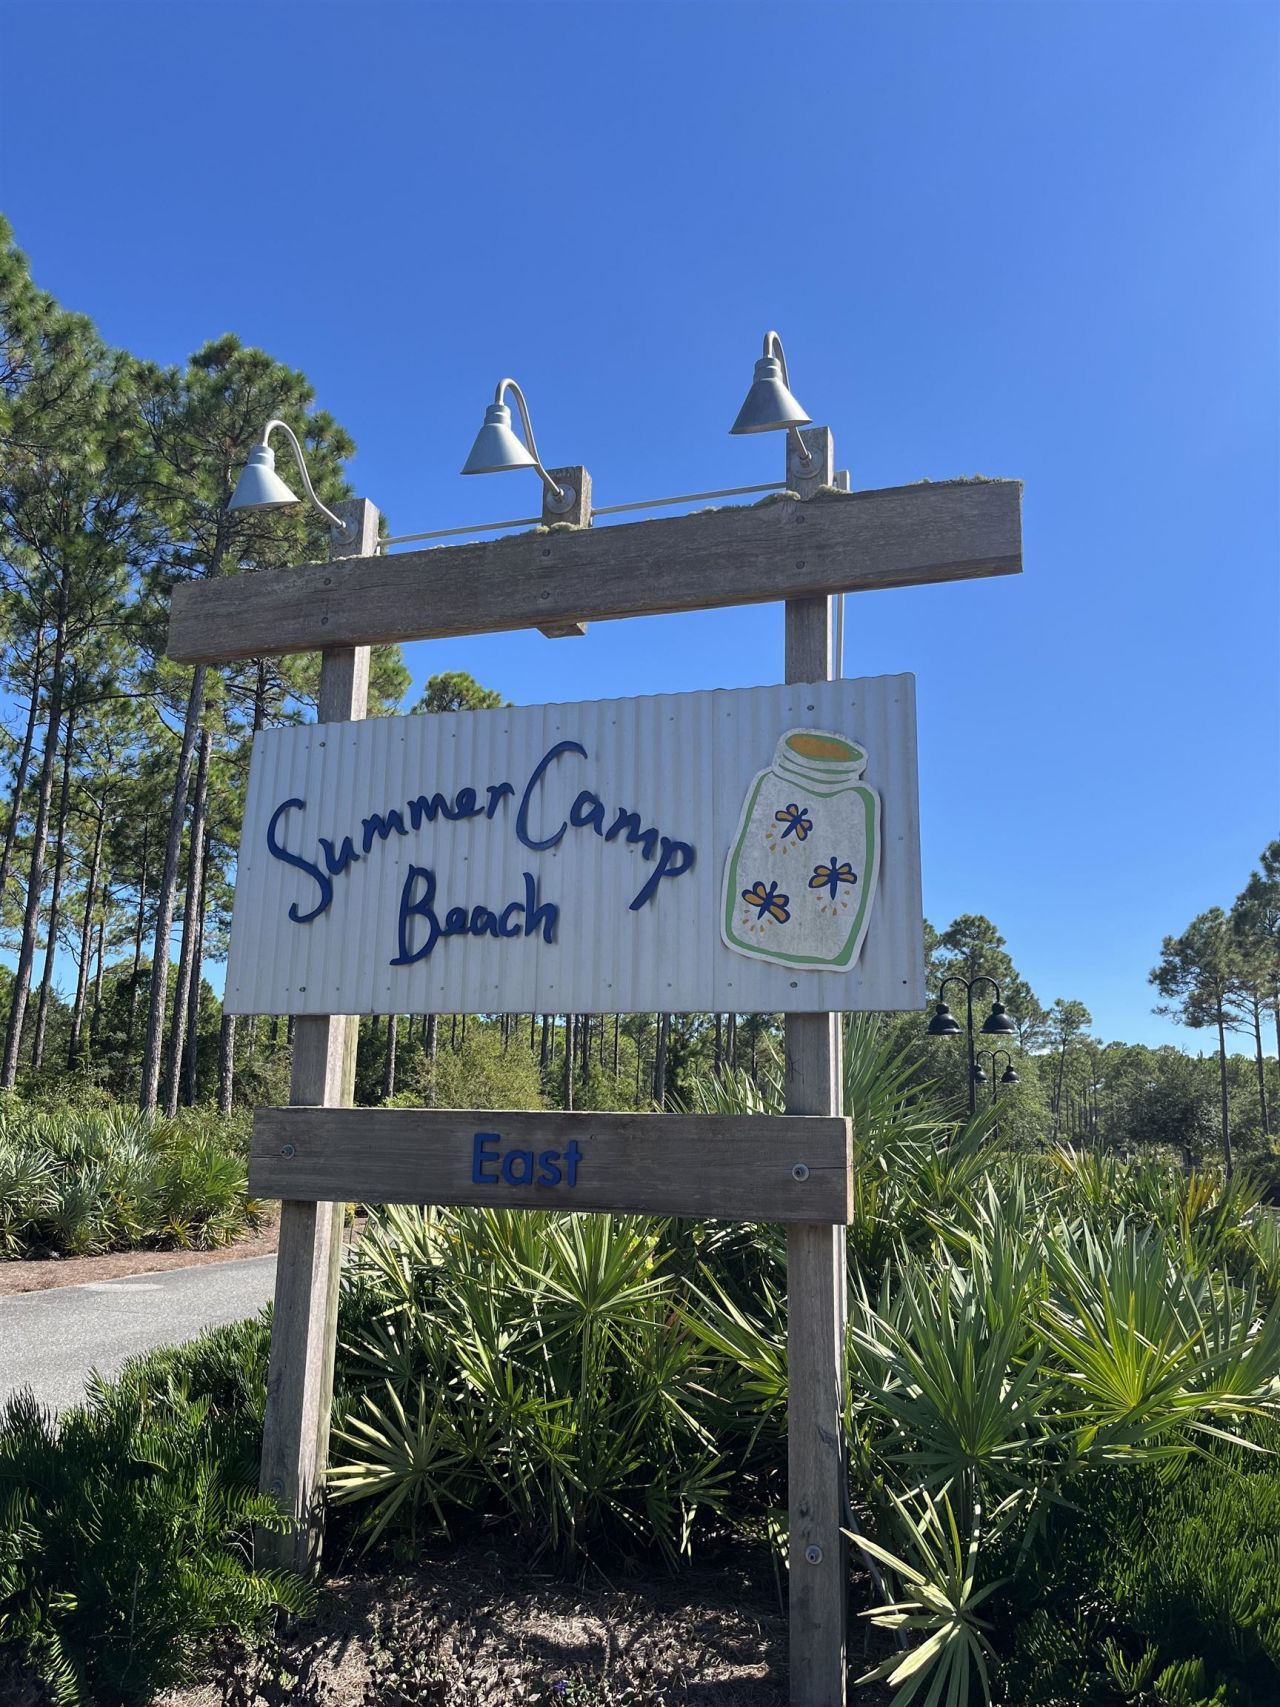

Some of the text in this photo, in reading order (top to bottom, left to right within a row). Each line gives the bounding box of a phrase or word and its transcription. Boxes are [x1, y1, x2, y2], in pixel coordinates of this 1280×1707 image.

[267, 741, 696, 924] Summer Camp
[390, 864, 559, 966] Beach
[471, 1131, 584, 1187] East
